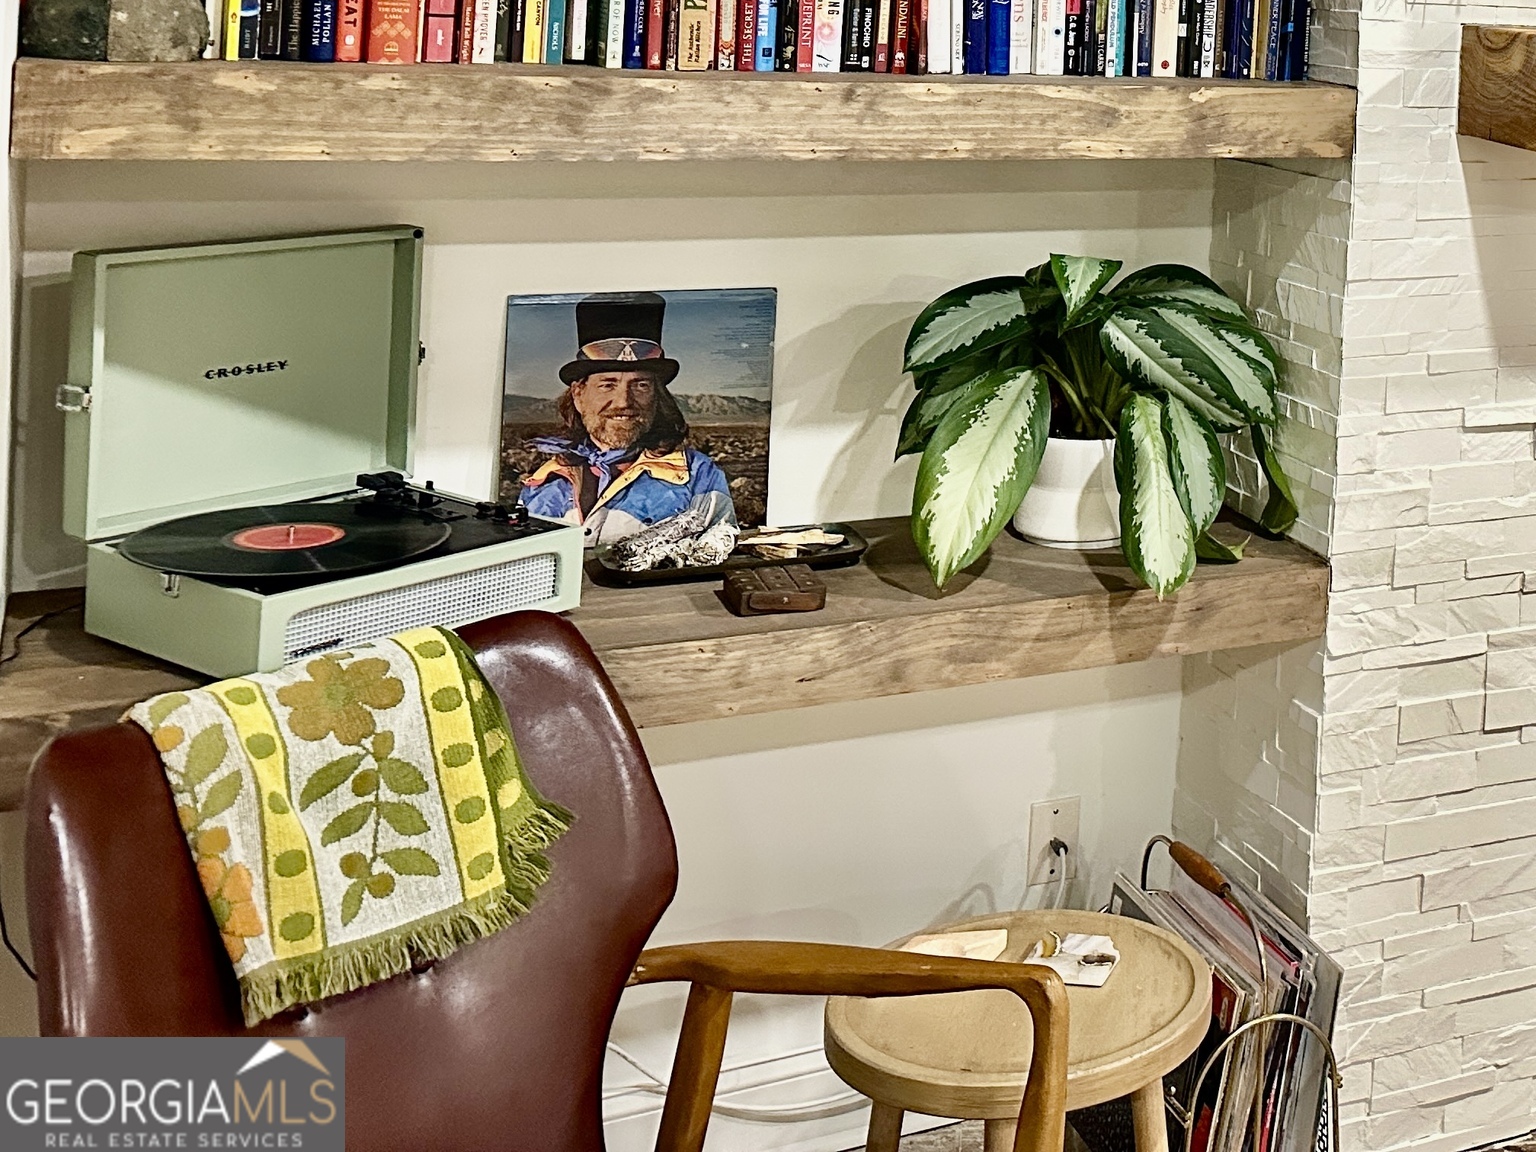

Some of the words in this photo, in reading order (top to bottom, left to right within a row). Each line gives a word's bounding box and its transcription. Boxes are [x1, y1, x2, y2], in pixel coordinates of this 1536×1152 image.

[312, 0, 322, 46] MICHAEL
[322, 4, 332, 43] POLLAN
[464, 7, 472, 27] Harold
[613, 8, 620, 21] OF
[742, 2, 754, 40] SECRET
[479, 13, 489, 41] HOOVER
[552, 22, 560, 50] NICHOLS
[611, 24, 620, 45] NOW
[757, 18, 768, 37] LIFE
[862, 8, 872, 48] FINOCHIO
[1108, 11, 1117, 48] PENDULUM
[1269, 21, 1279, 48] PEACE
[287, 34, 299, 52] The
[461, 39, 470, 60] Wright
[741, 43, 753, 64] THE
[203, 360, 288, 379] CROSLEY
